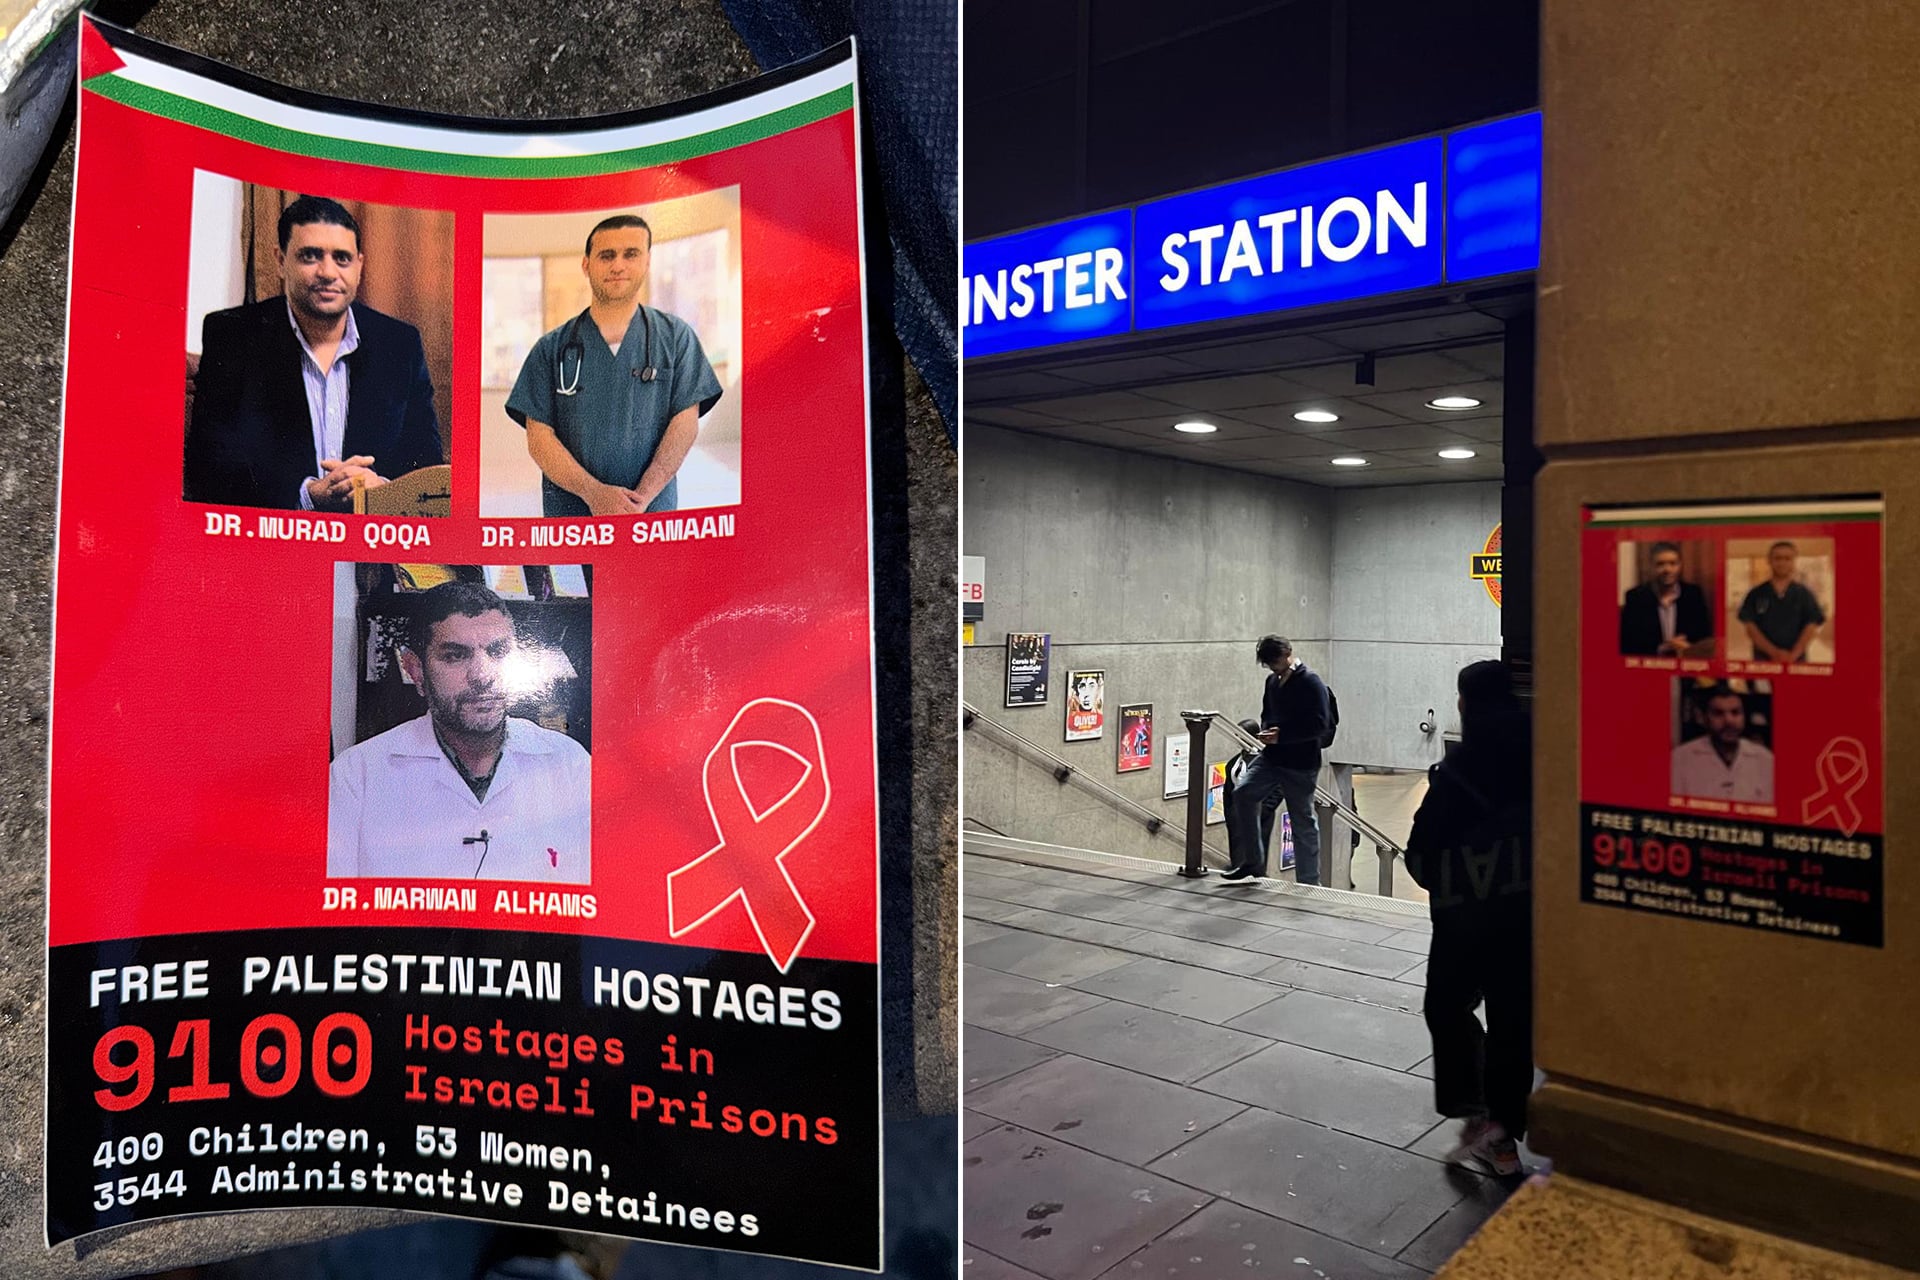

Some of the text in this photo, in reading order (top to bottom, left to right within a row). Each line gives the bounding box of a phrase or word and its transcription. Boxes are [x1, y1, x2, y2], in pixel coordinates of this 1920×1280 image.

[1159, 181, 1428, 293] STATION
[204, 512, 432, 550] DR.MURAD QOQA
[481, 514, 736, 548] DR.MUSAB SAMAAN
[1591, 810, 1873, 861] FREE PALESTINIAN HOSTAGES
[1591, 832, 1693, 879] 9100
[321, 886, 598, 919] DR.MARWAN ALHAMS
[89, 953, 843, 1031] FREE PALESTINIAN HOSTAGES
[92, 1011, 374, 1113] 9100
[404, 1012, 715, 1076] Hostages in
[404, 1064, 840, 1146] Israeli Prisons
[92, 1122, 611, 1180] 400 Children, 53 Women,
[92, 1160, 761, 1237] 3544 Administrative Detainees
